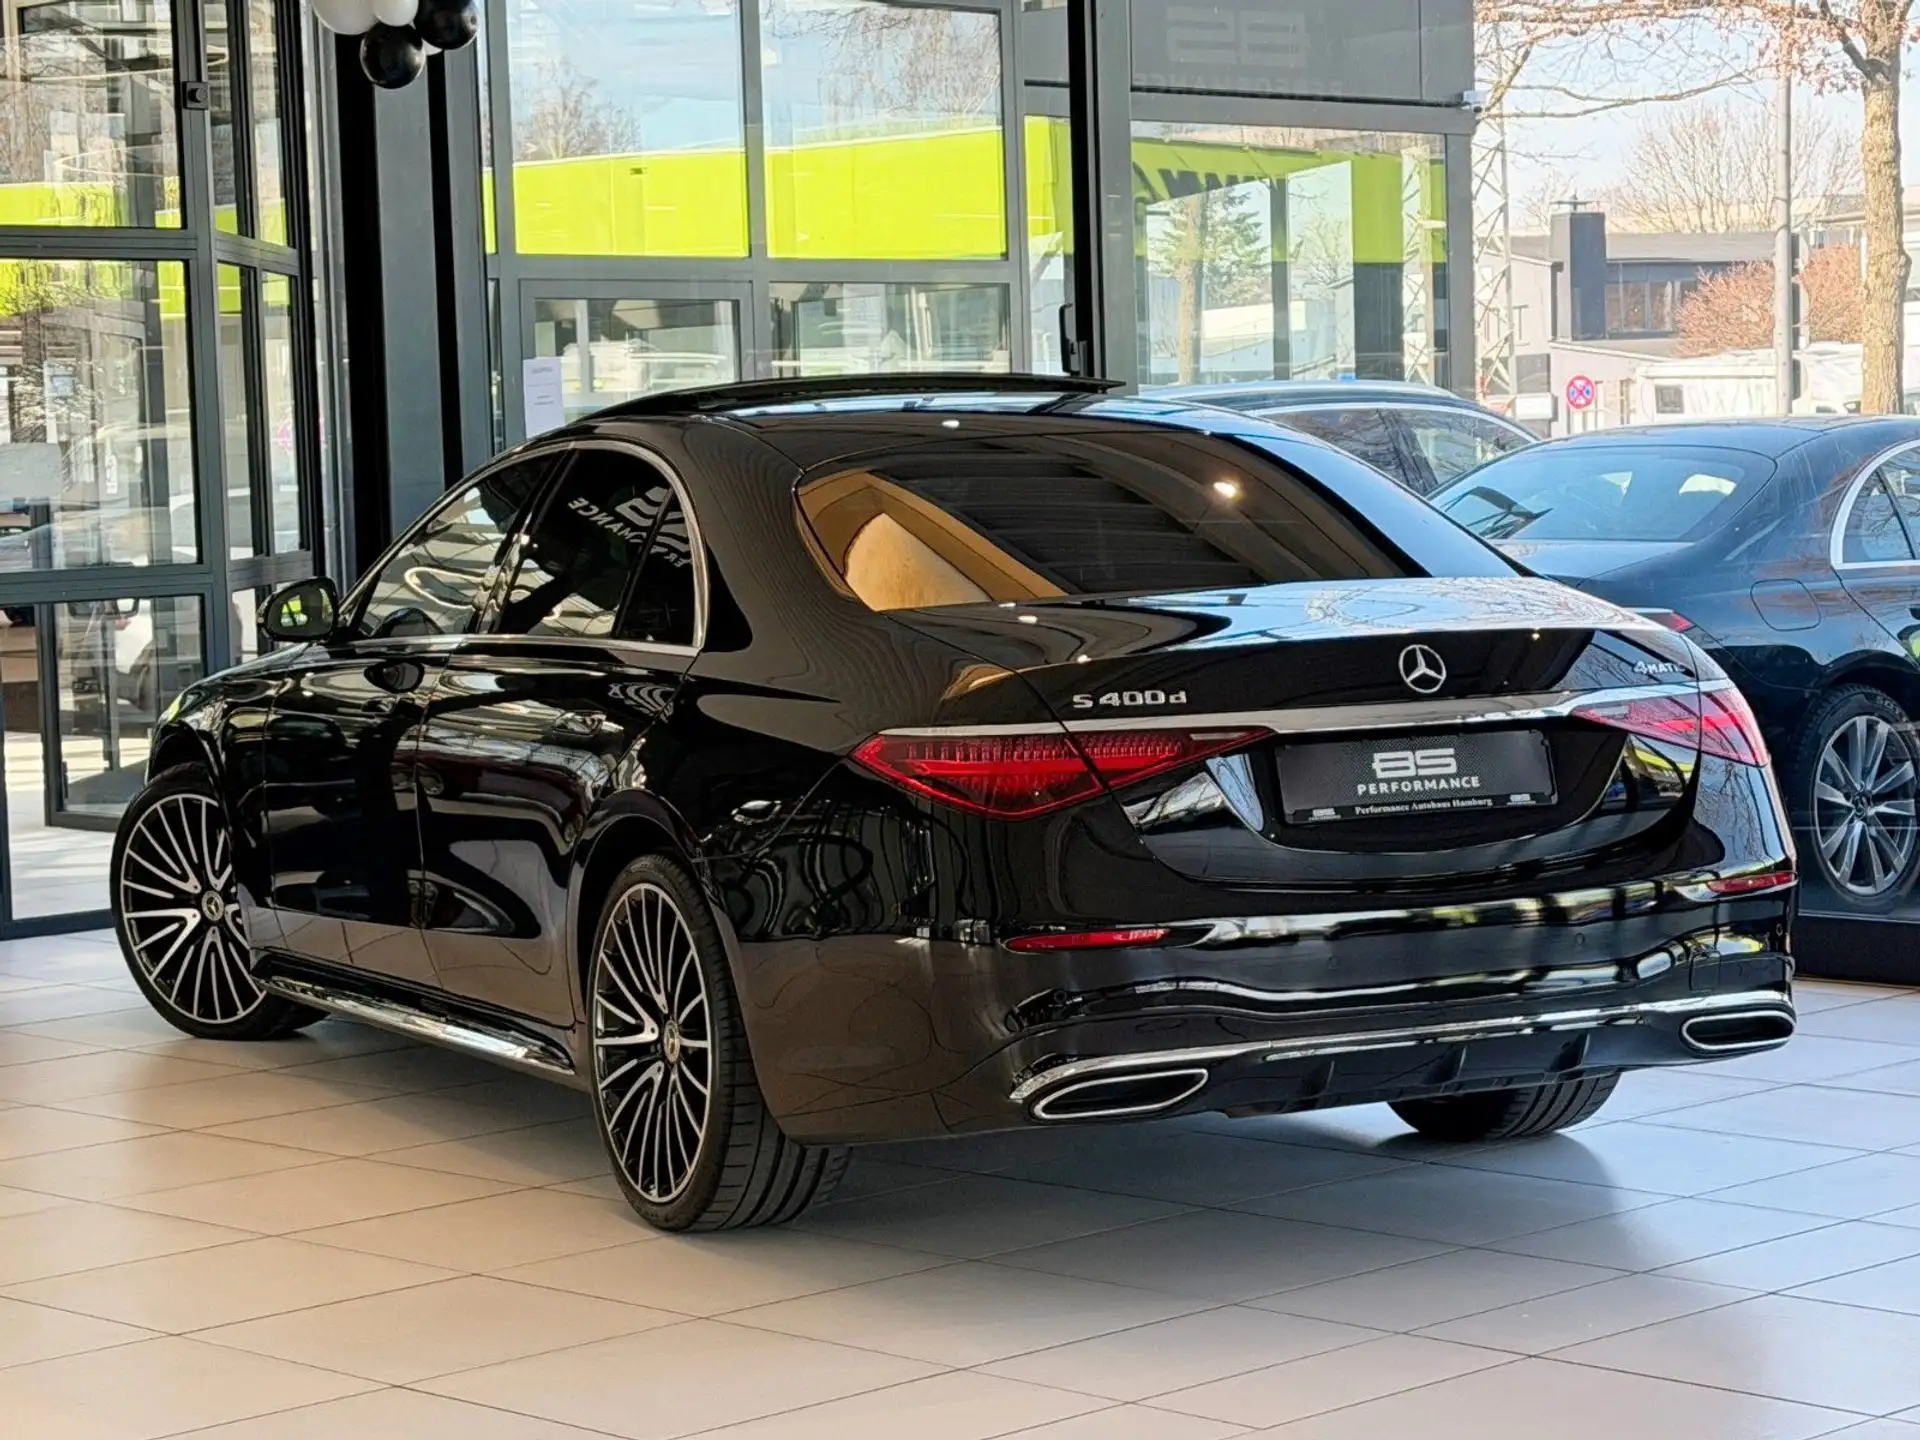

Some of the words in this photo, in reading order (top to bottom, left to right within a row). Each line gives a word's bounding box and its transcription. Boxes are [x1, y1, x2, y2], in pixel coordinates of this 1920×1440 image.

[1357, 776, 1480, 795] PERFORMANCE
[1355, 804, 1409, 815] Performance
[1411, 800, 1451, 810] Autohaus
[1452, 798, 1493, 808] Hamburg
